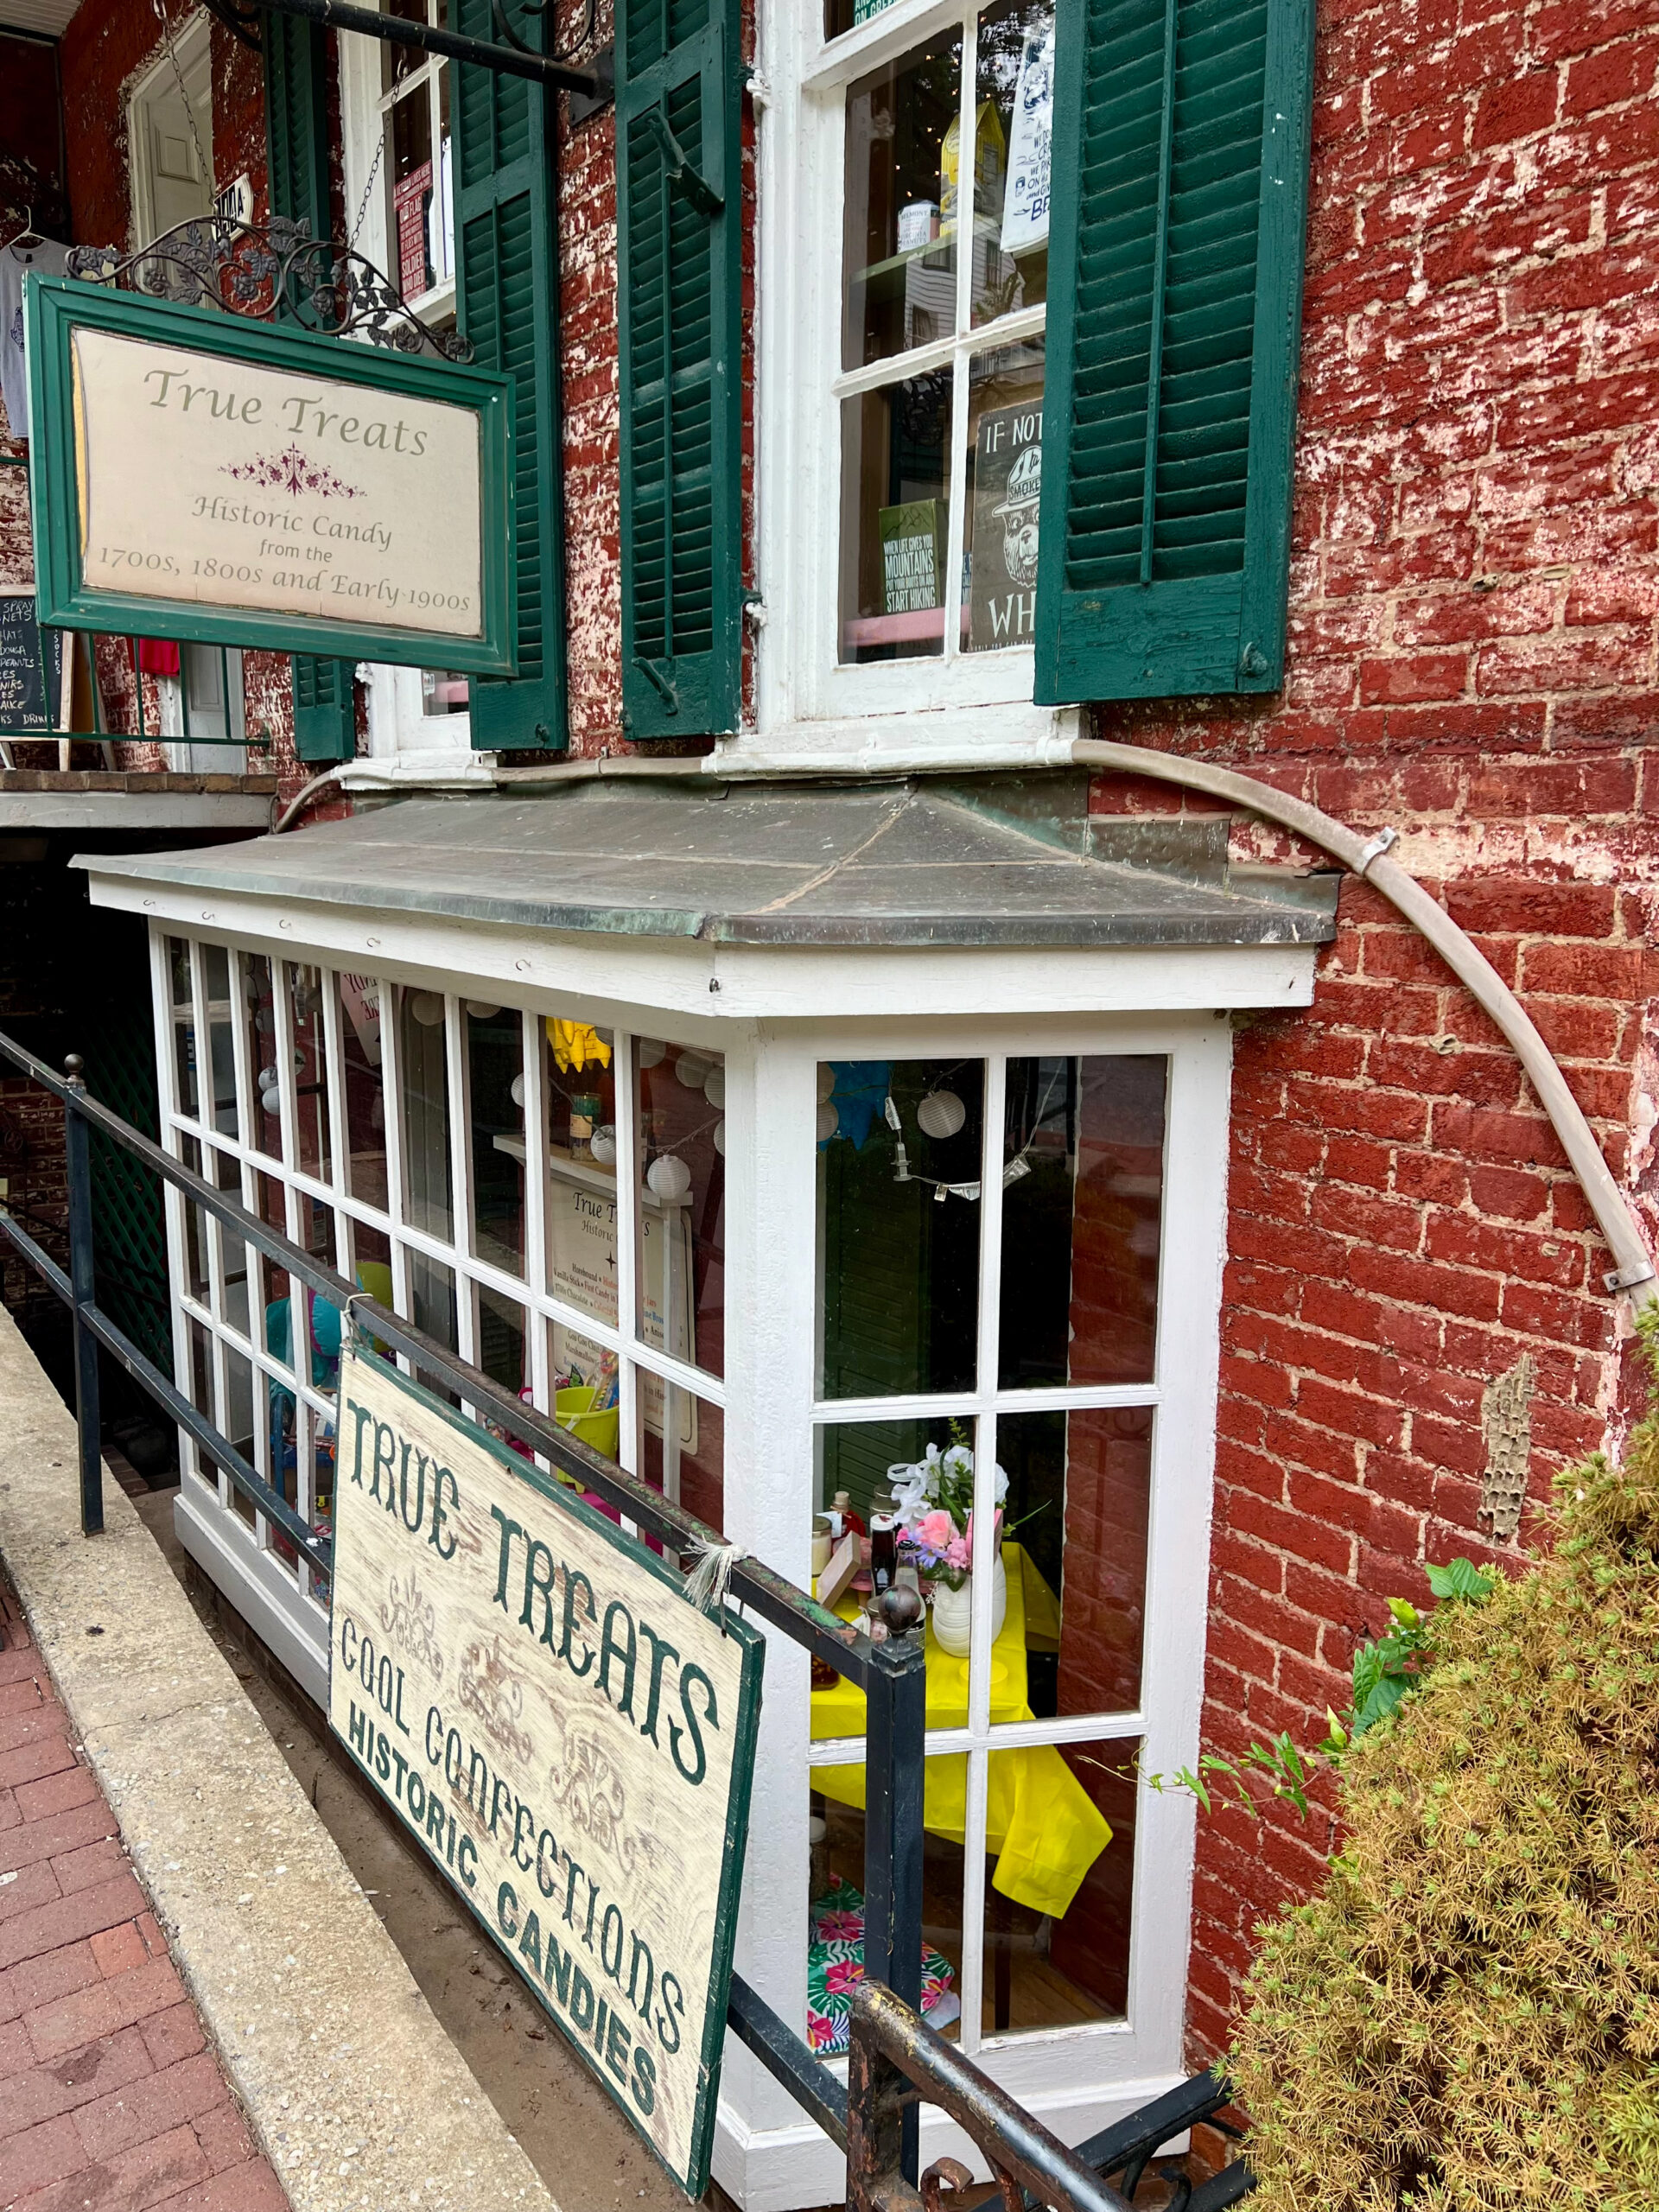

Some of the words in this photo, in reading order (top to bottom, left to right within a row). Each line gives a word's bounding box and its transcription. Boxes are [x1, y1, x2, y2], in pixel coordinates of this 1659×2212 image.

[144, 369, 262, 424] True
[282, 397, 428, 455] Treats
[986, 421, 1005, 454] IF
[1012, 412, 1043, 446] NOT
[192, 496, 303, 532] Historic
[313, 516, 392, 552] Candy
[259, 539, 299, 558] from
[306, 546, 333, 563] the
[884, 540, 899, 555] WHEN
[899, 538, 908, 553] LIFE
[908, 536, 923, 551] GIVES
[922, 533, 933, 549] YOU
[885, 549, 934, 580] MOUNTAINS
[99, 547, 181, 576] 1700s,
[192, 558, 263, 583] 1800s
[272, 569, 328, 592] and
[330, 574, 400, 608] Early
[408, 589, 470, 612] 1900s
[3, 600, 35, 613] SPRAY
[887, 589, 909, 613] START
[910, 586, 936, 610] HIKING
[3, 610, 32, 626] NETS
[0, 658, 35, 668] PEANUTS
[22, 713, 54, 725] DRINS
[573, 1192, 602, 1219] True
[582, 1219, 613, 1243] Historic
[346, 1397, 461, 1560] TRUE
[491, 1503, 720, 1786] TREATS
[341, 1618, 410, 1738] COOL
[426, 1706, 685, 2055] CONFECTIONS
[349, 1700, 478, 1888] HISTORIC
[497, 1881, 657, 2116] CANDIES
